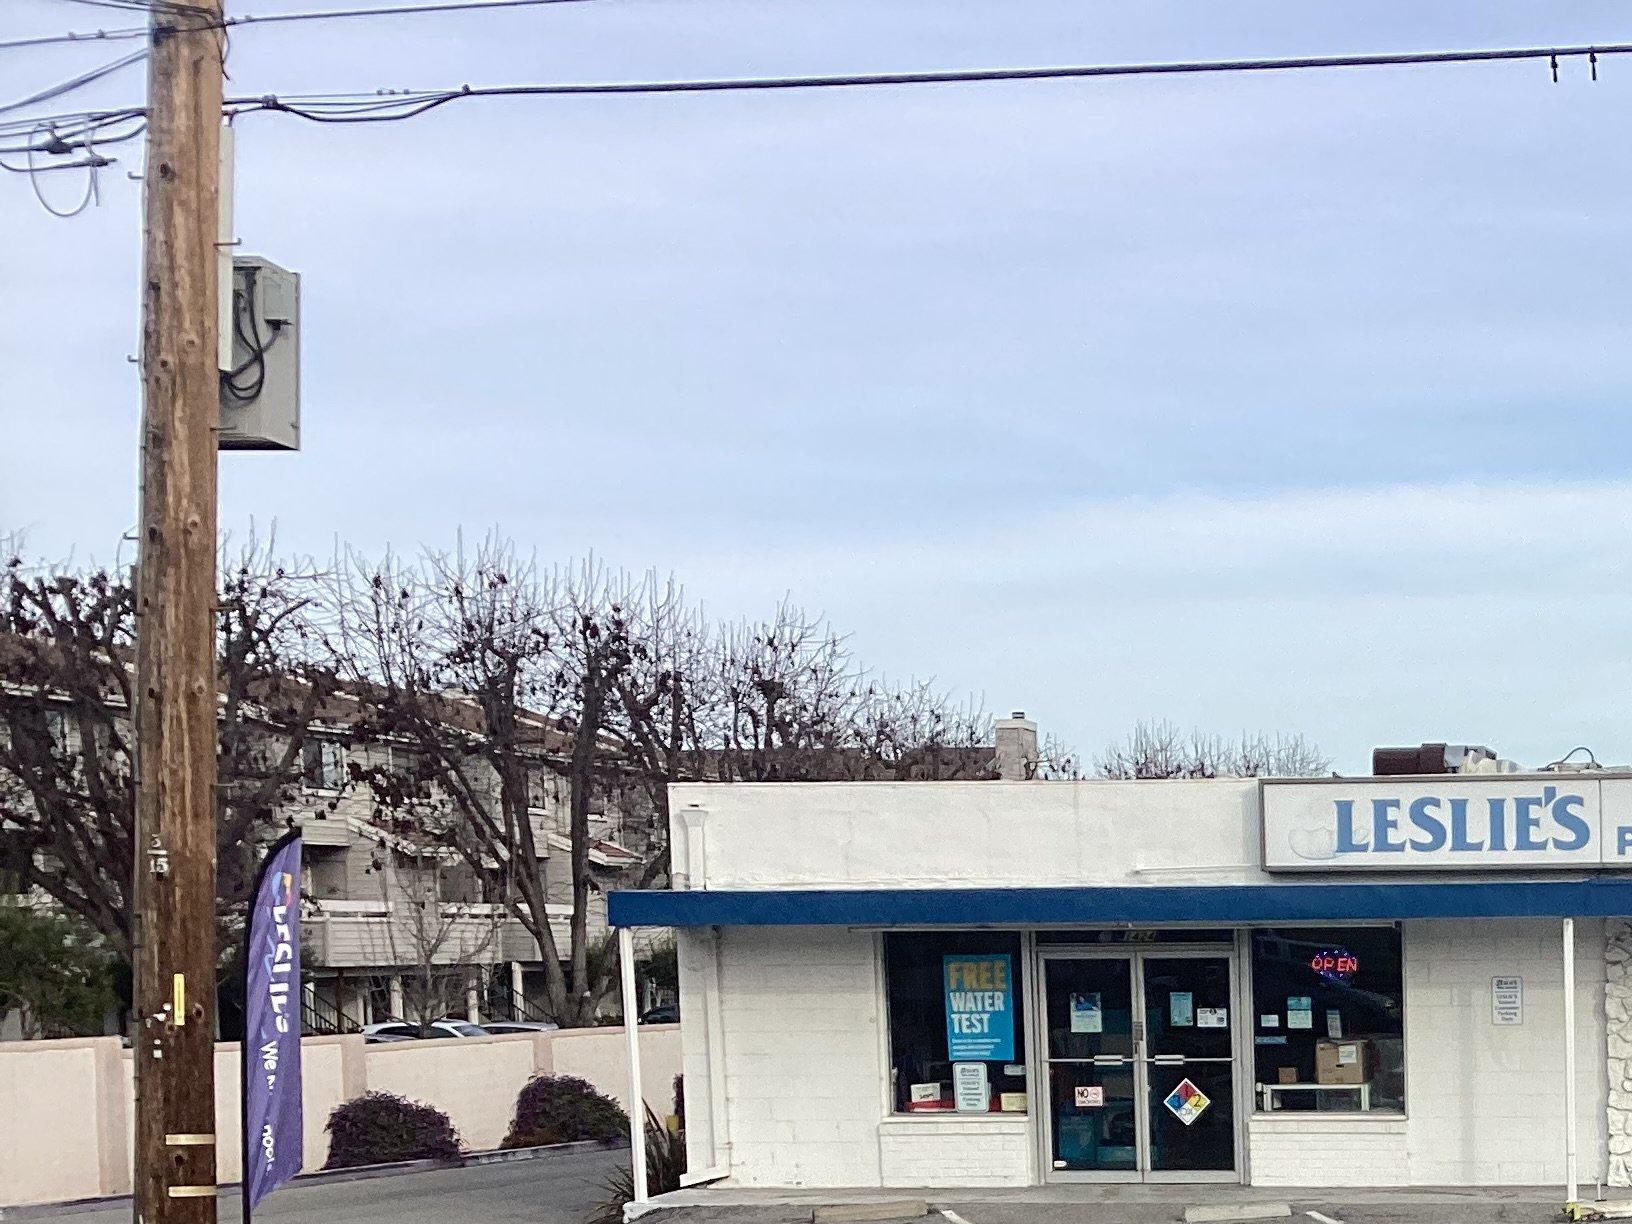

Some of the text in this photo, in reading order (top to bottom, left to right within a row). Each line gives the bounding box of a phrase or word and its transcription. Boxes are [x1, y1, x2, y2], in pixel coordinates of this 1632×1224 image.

[1334, 786, 1591, 854] LESLIE'S
[1311, 957, 1358, 972] OPEN
[949, 961, 1006, 989] FREE
[950, 991, 1005, 1011] WATER
[951, 1013, 990, 1033] TEST
[260, 1041, 278, 1071] We
[1077, 1088, 1089, 1098] NO
[1194, 1094, 1202, 1107] 2
